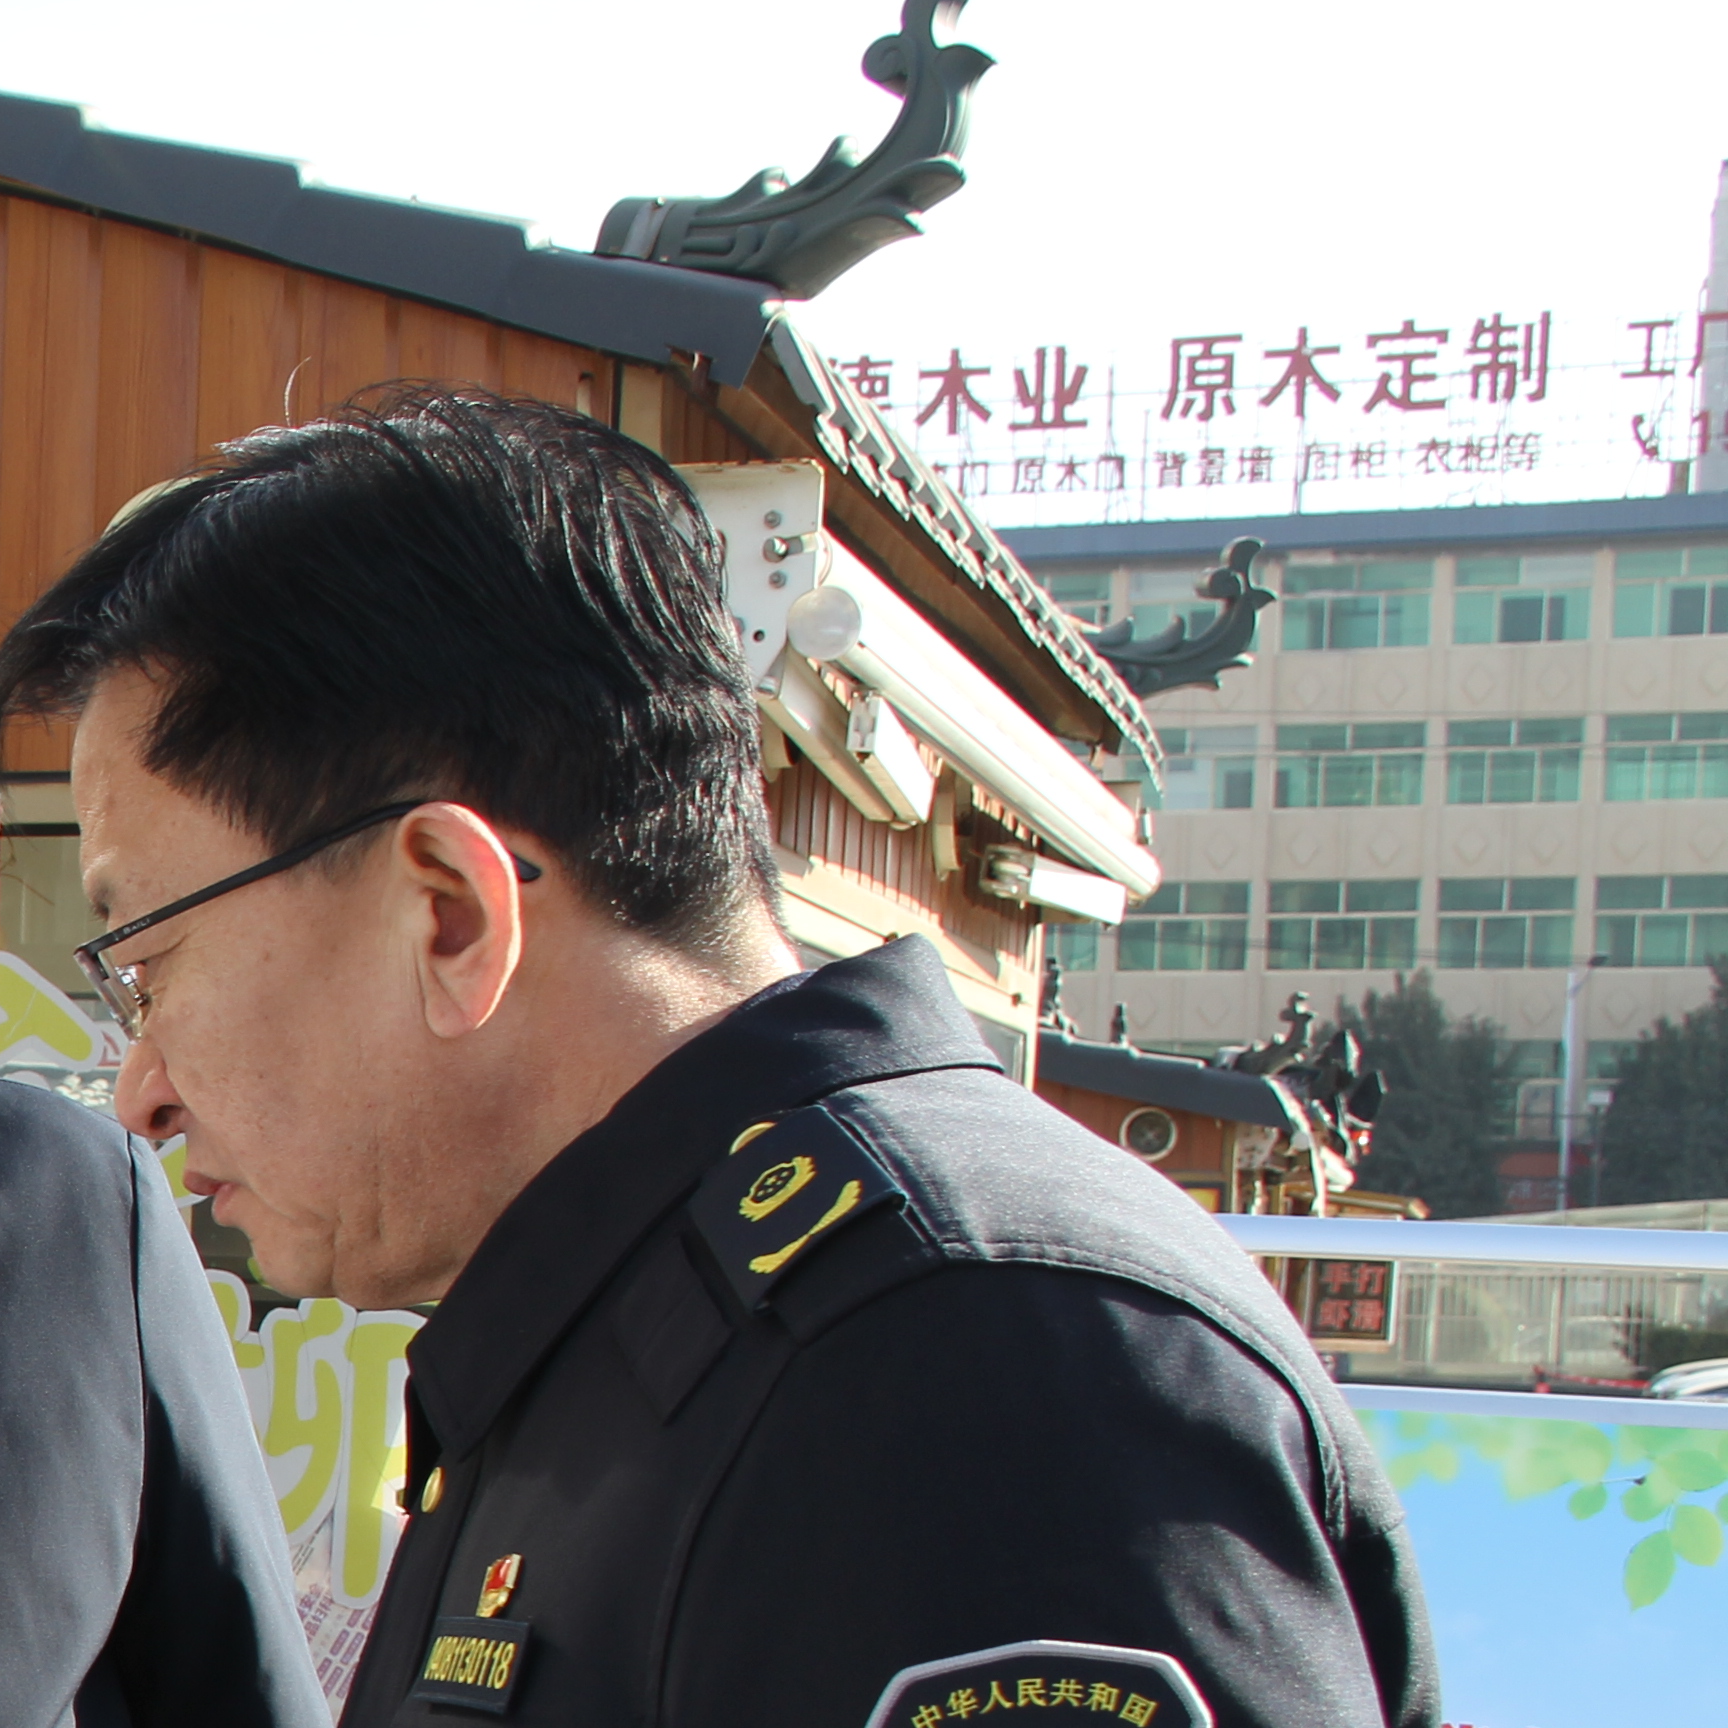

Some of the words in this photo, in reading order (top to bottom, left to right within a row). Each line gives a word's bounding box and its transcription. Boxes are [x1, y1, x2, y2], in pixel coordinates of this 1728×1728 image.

[1161, 310, 1551, 421] 原木定制
[1012, 454, 1125, 494] 原木门
[1155, 446, 1273, 487] 背景墙
